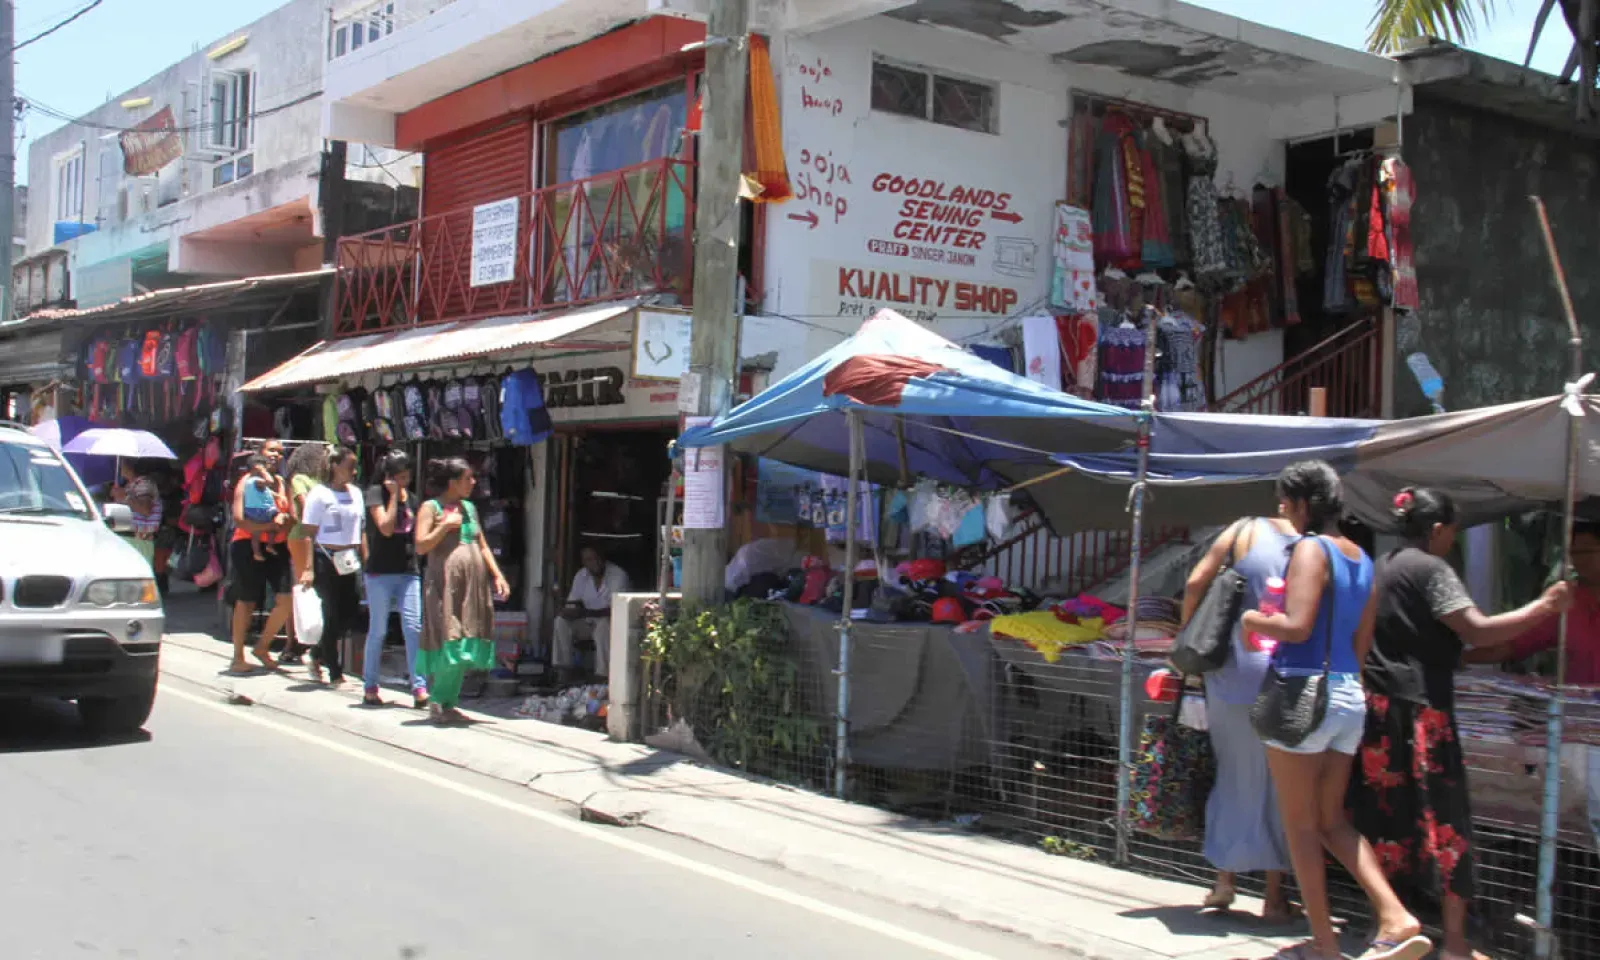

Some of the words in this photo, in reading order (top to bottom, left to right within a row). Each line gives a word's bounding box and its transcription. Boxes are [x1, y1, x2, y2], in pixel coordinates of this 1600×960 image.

[872, 172, 1012, 211] GOODLANDS
[898, 199, 985, 228] SEWING
[893, 220, 987, 249] CENTER
[911, 246, 945, 263] SINGER
[839, 267, 950, 307] KWALITY
[954, 281, 1018, 315] SHOP
[538, 366, 625, 408] MIR
